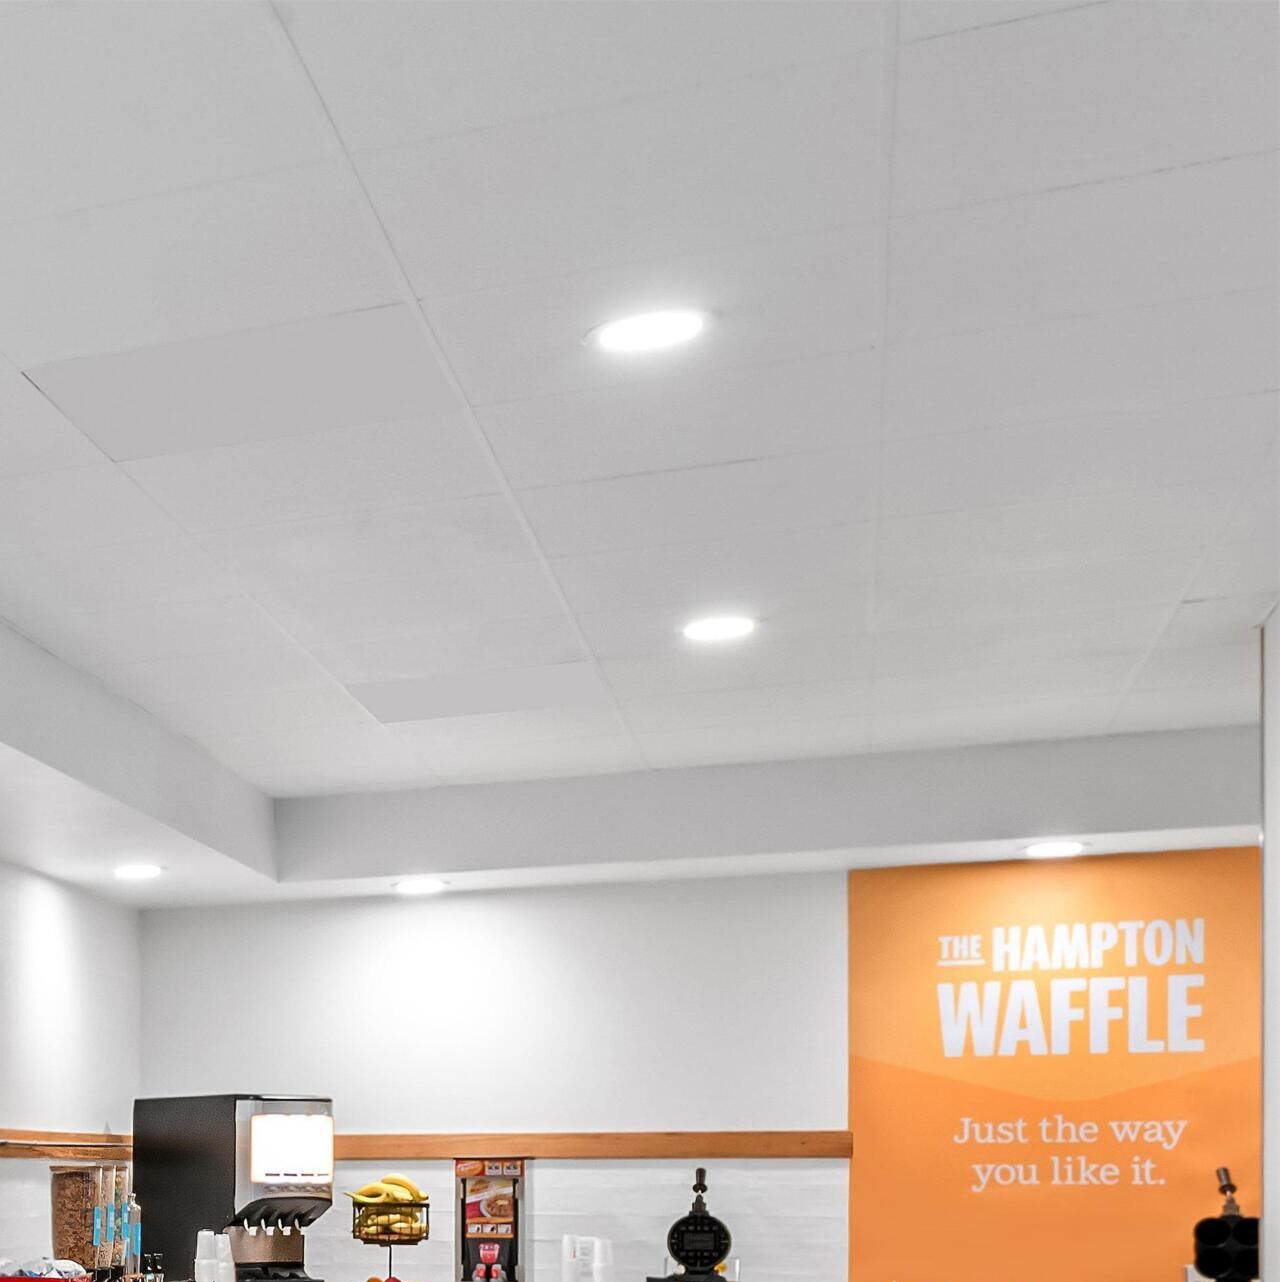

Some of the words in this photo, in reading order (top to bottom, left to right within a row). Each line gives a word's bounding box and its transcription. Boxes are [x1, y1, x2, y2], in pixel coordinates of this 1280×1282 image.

[939, 934, 982, 958] THE
[992, 919, 1205, 971] HAMPTON
[936, 974, 1206, 1058] WAFFLE
[953, 1116, 1028, 1144] Just
[1040, 1114, 1099, 1143] the
[1110, 1119, 1188, 1149] way
[972, 1162, 1040, 1192] you
[1051, 1155, 1120, 1186] like
[1131, 1156, 1167, 1185] it.
